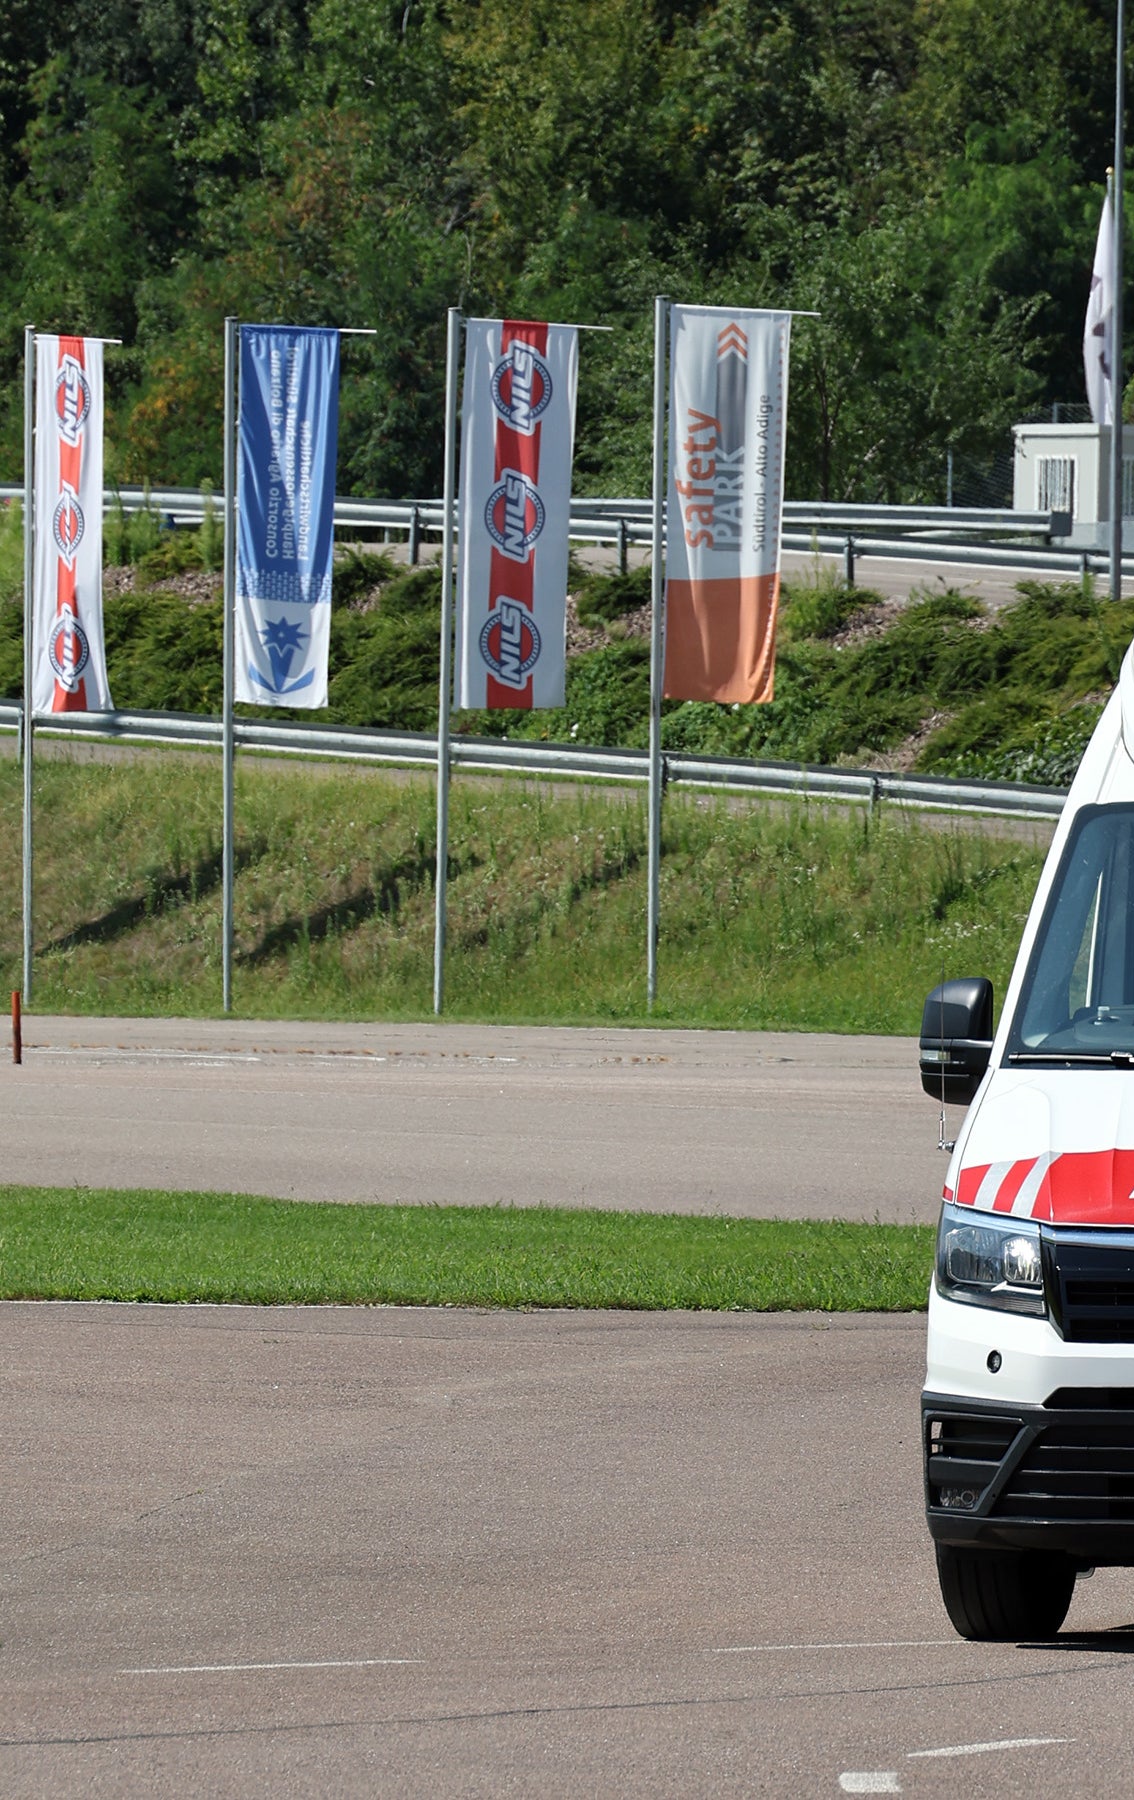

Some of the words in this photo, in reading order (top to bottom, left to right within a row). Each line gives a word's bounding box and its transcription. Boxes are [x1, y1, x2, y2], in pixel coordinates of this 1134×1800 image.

[508, 345, 534, 431] NILS
[756, 394, 773, 440] Adige
[675, 407, 723, 549] safety
[712, 446, 744, 552] PARK
[755, 446, 768, 477] Alto
[502, 473, 527, 558] NILS
[753, 492, 766, 552] Südtirol
[499, 601, 523, 685] NILS
